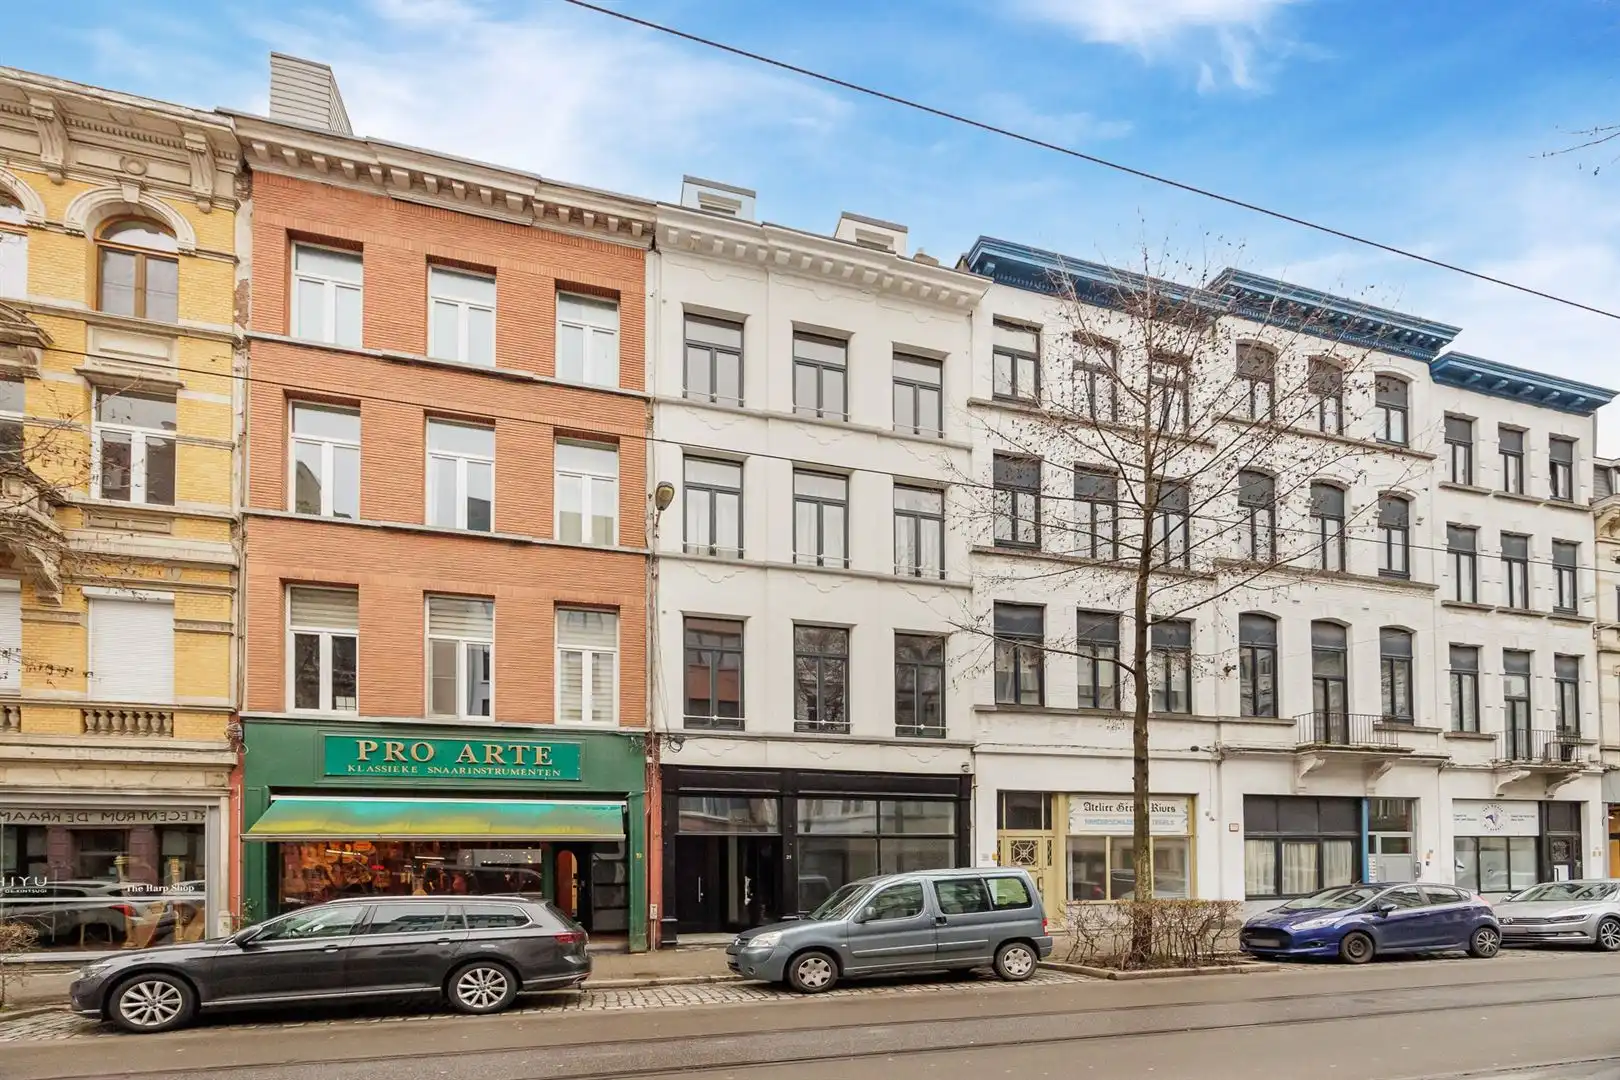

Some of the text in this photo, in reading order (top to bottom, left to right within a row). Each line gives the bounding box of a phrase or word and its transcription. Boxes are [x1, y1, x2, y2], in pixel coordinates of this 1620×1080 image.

[356, 739, 554, 767] PRO ARTE
[347, 764, 561, 777] KLASSIEKE SNAARINSTRUMENTEN
[1083, 801, 1114, 812] Atelier
[127, 884, 195, 894] The Harp Shop
